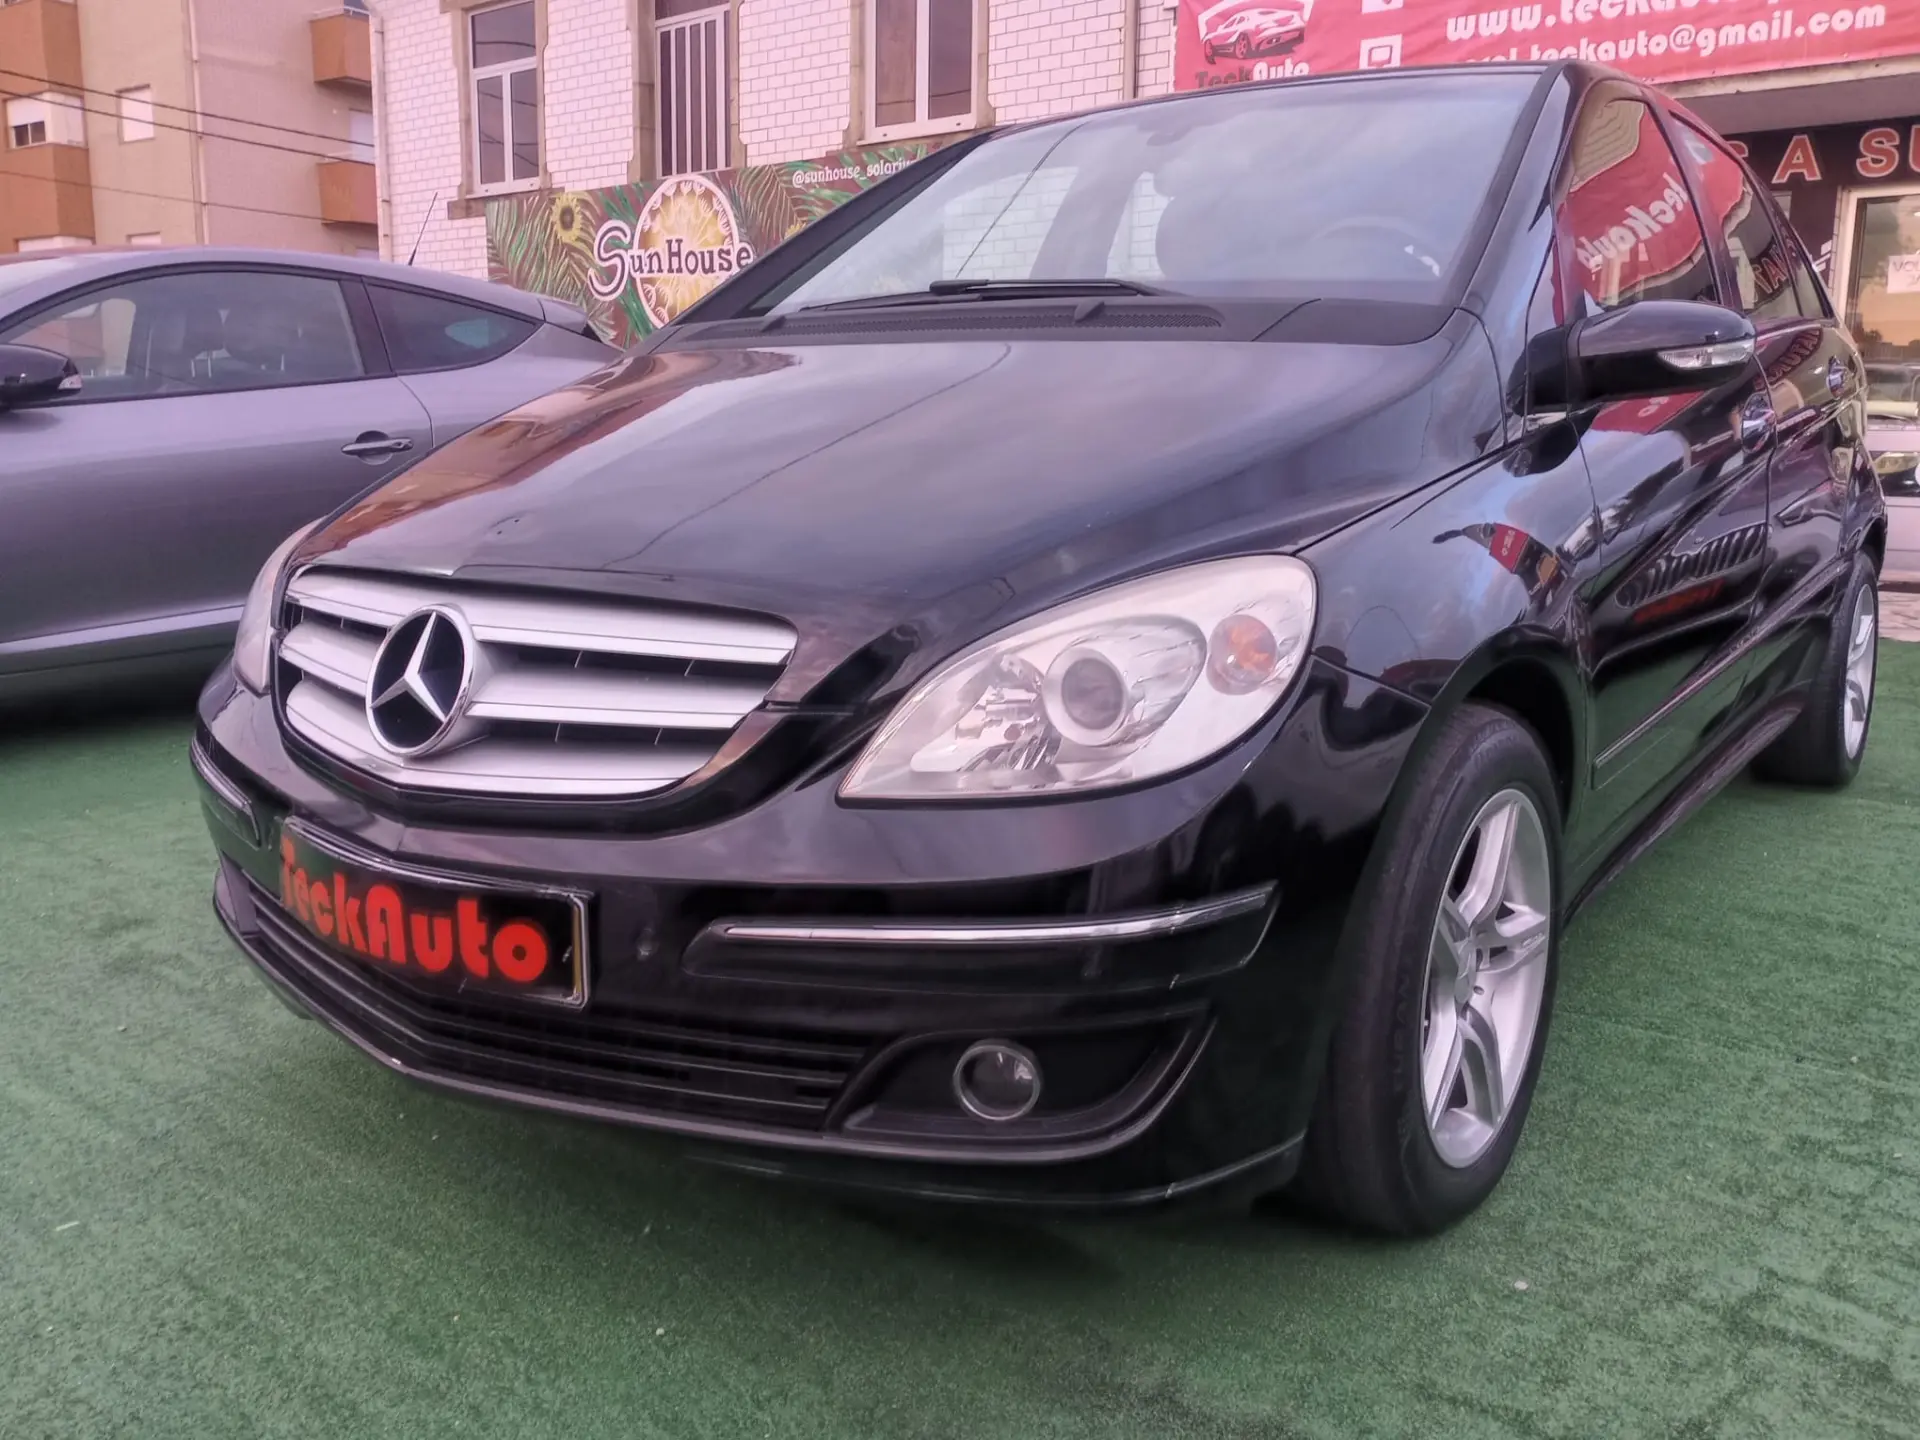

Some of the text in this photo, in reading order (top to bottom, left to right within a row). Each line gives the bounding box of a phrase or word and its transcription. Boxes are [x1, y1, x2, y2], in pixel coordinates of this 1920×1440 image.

[792, 157, 918, 188] @sunhouse_solari
[587, 219, 754, 301] SunHouse
[281, 834, 548, 983] TeckAuto
